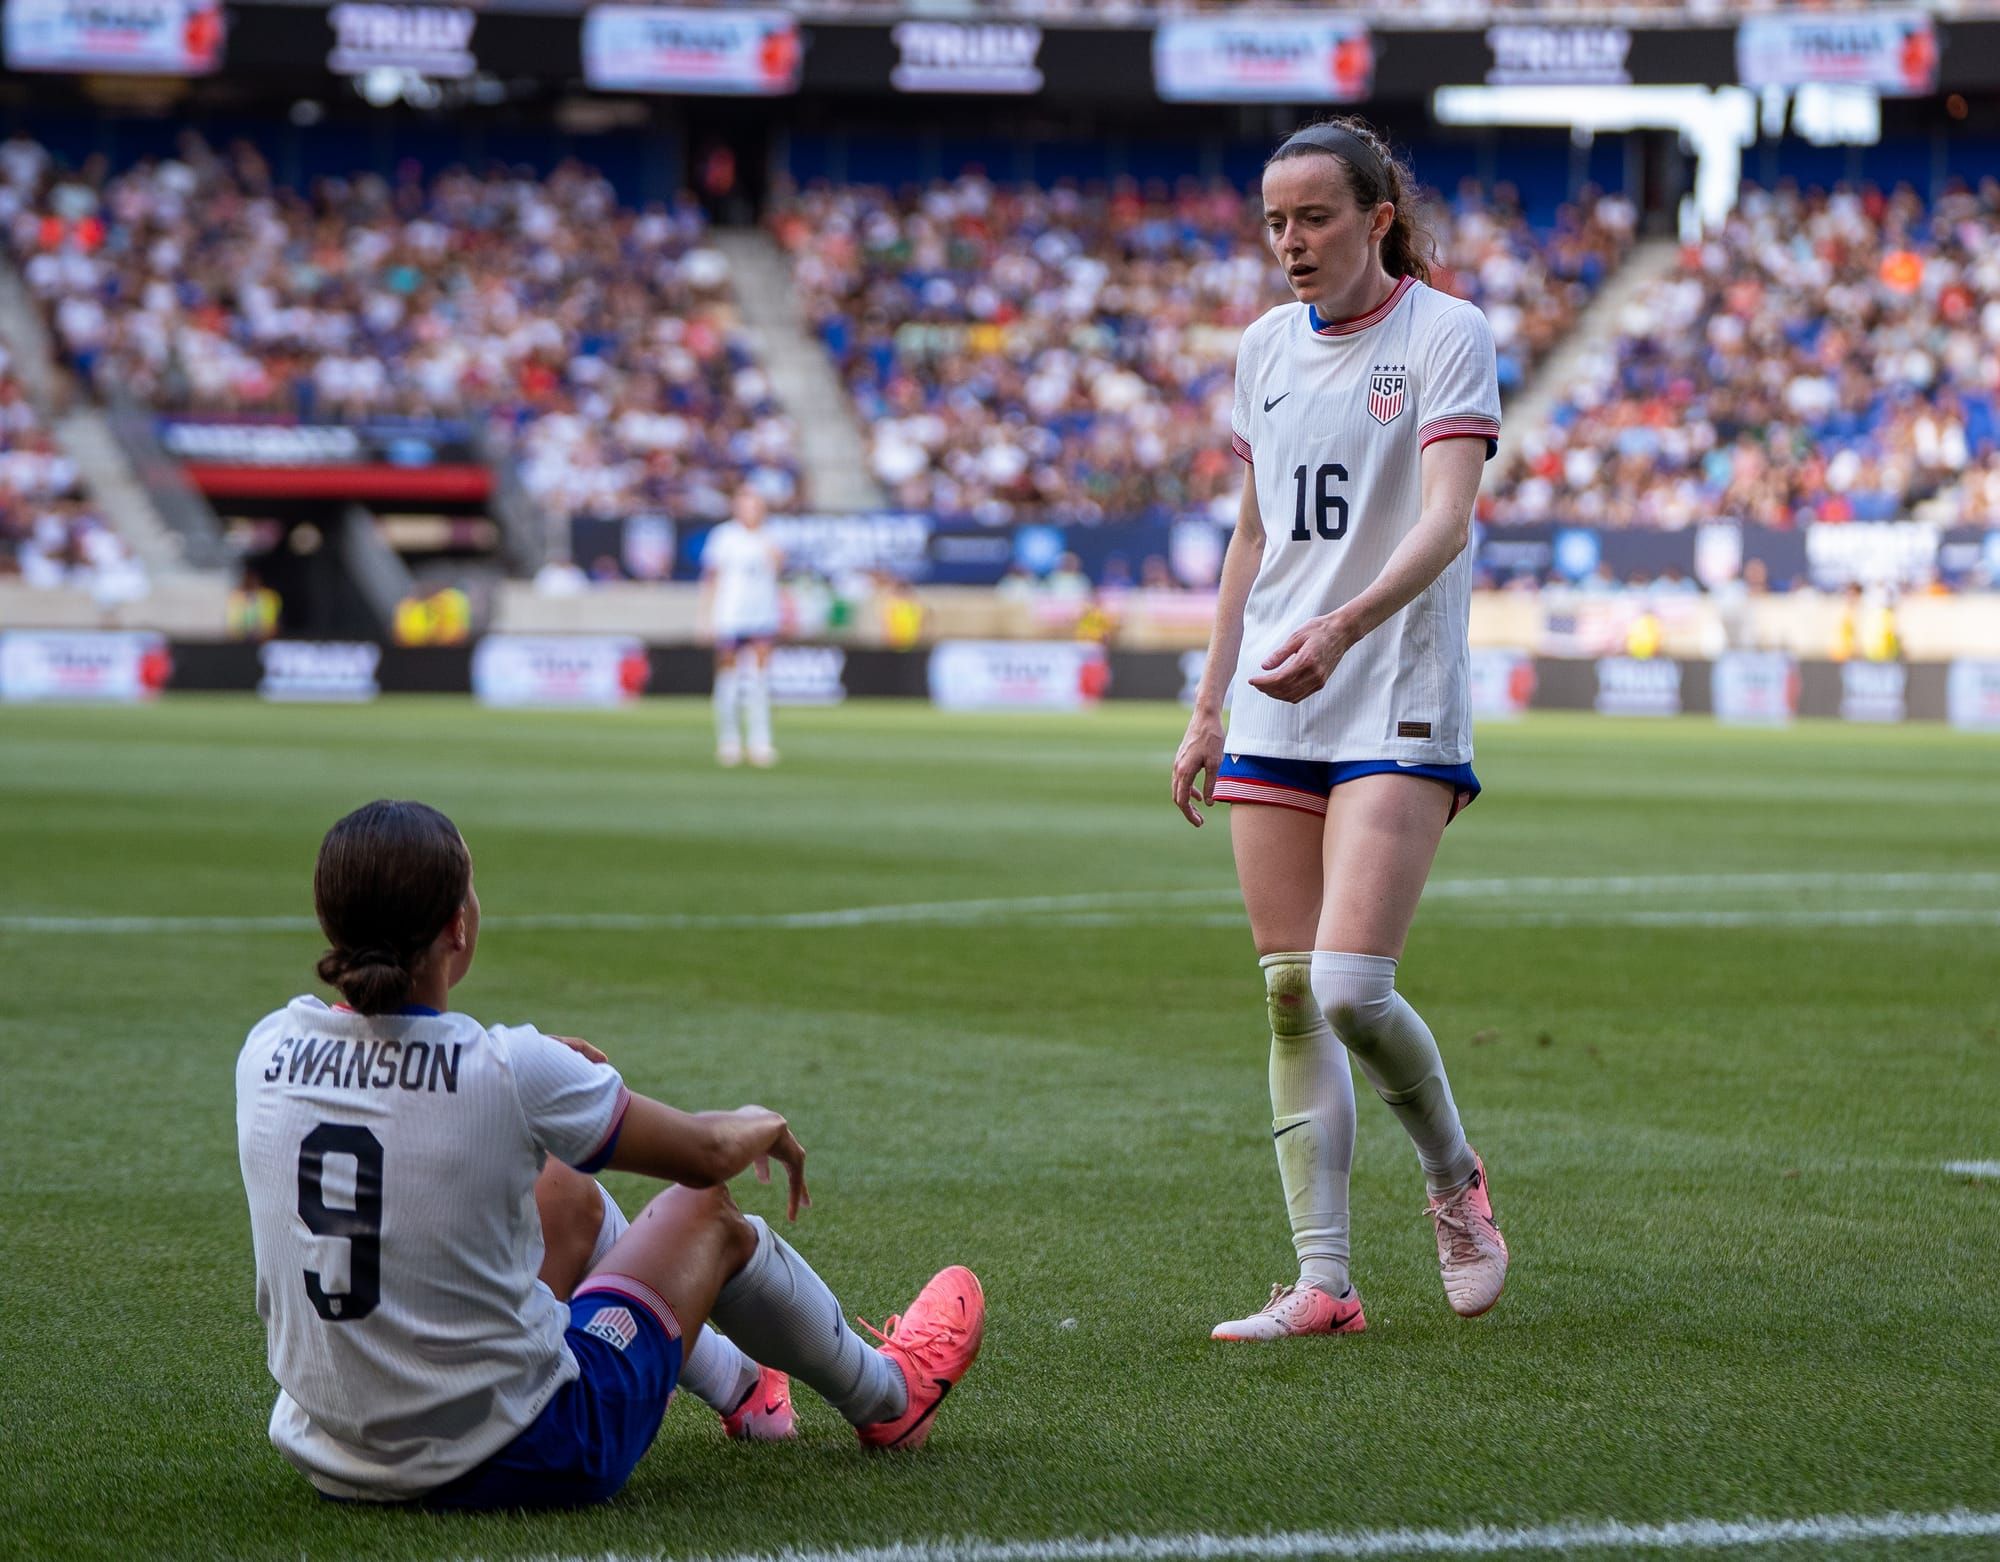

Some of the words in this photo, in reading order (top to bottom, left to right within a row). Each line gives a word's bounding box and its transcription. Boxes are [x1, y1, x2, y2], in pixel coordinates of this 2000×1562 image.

[1373, 377, 1404, 396] USA
[1291, 463, 1349, 541] 16
[264, 1037, 462, 1093] SWANSON
[298, 1122, 384, 1321] 9
